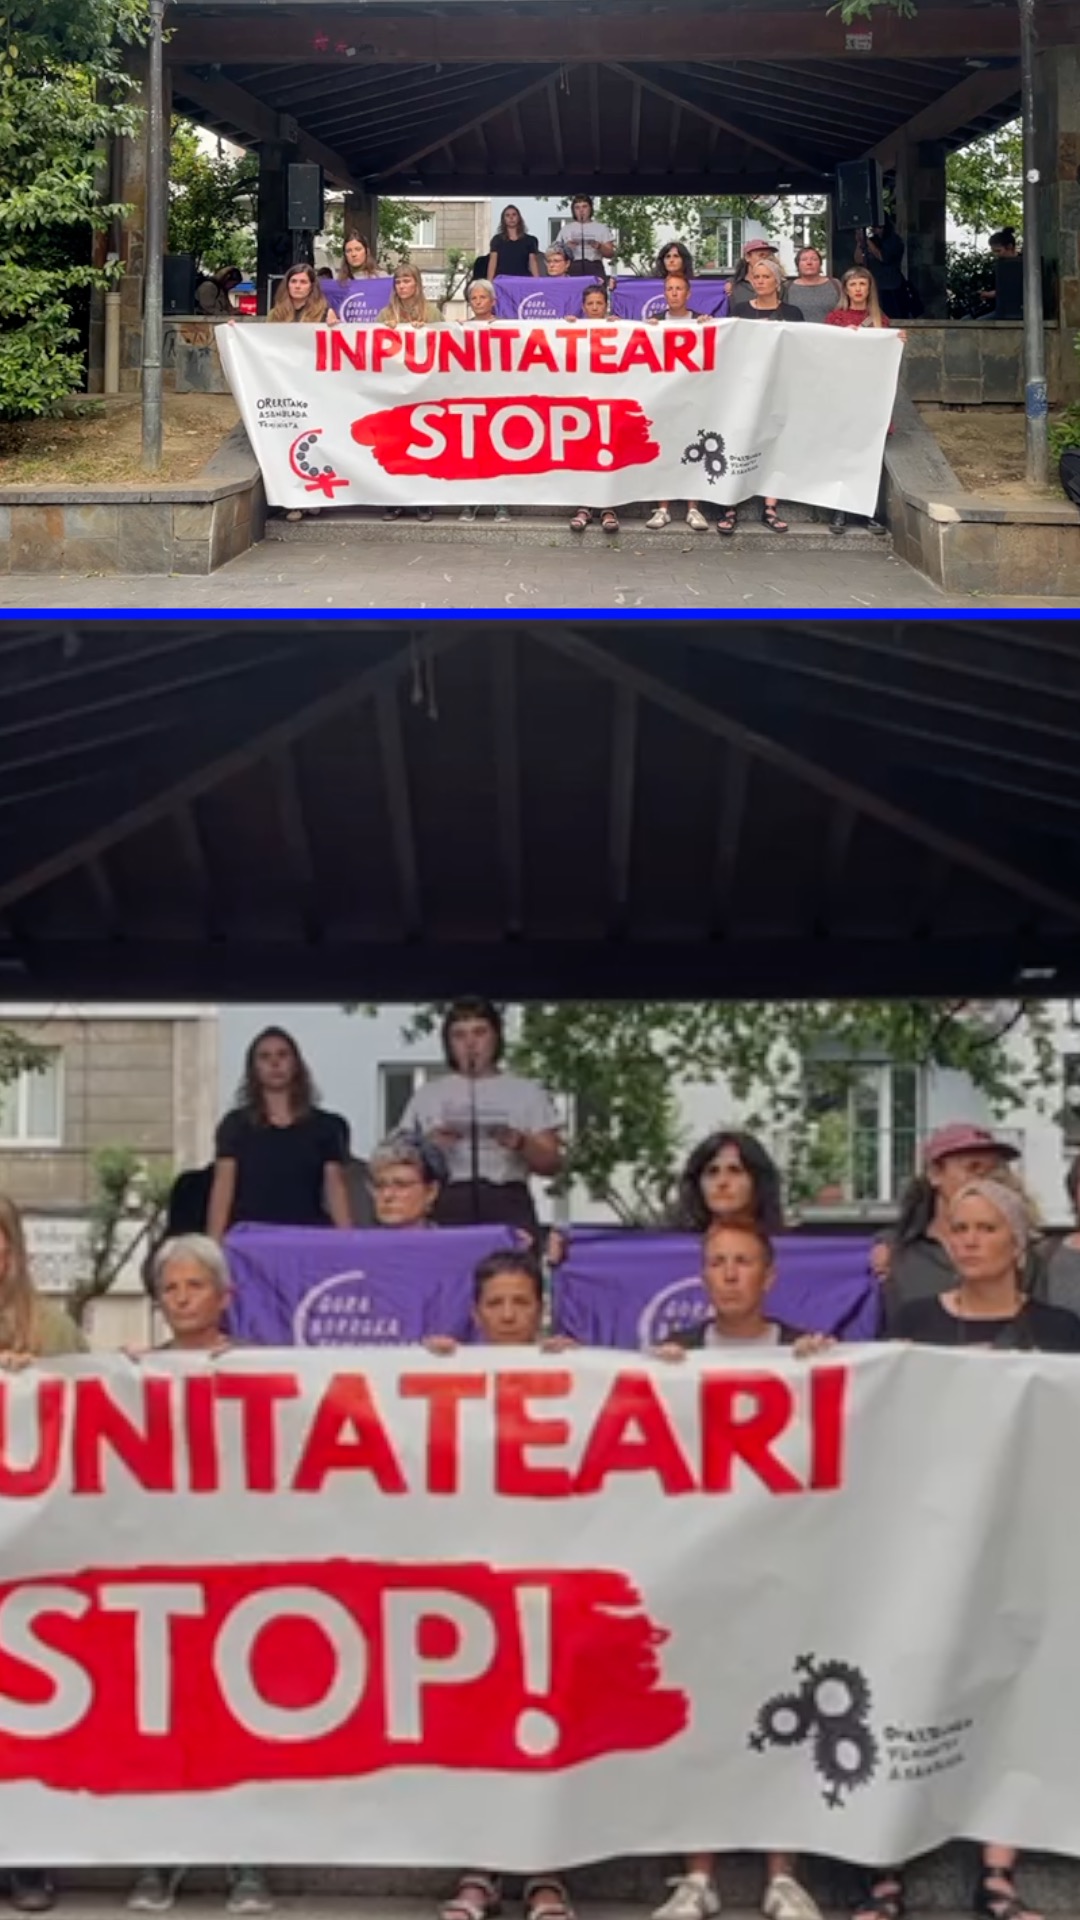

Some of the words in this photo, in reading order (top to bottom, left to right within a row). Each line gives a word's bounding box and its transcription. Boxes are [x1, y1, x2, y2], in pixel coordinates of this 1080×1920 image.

[314, 326, 717, 374] INPUNITATEARI
[256, 397, 309, 409] ORERETAKO
[405, 403, 615, 467] STOP!
[0, 1582, 560, 1758] STOP!
